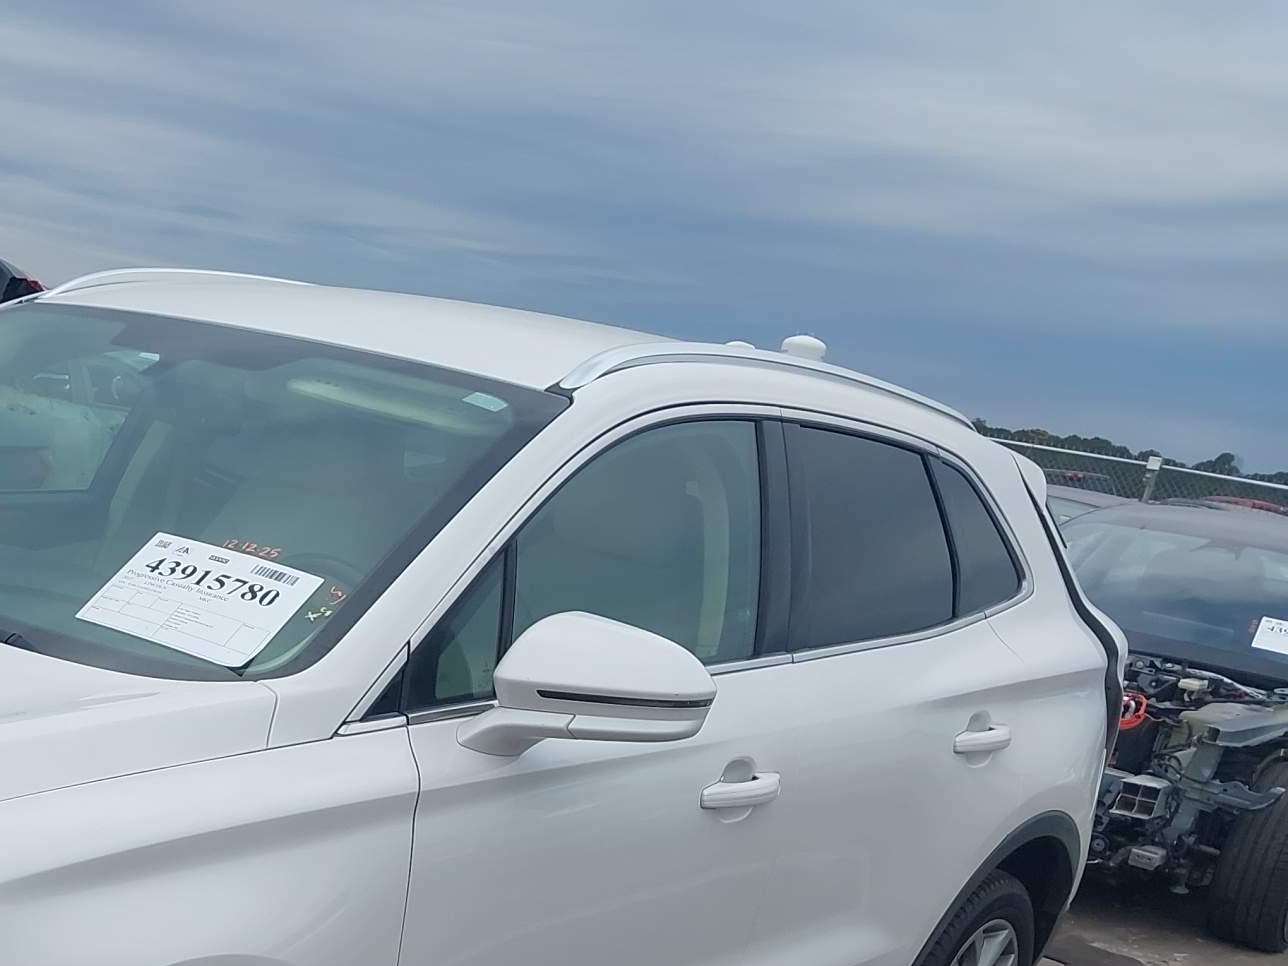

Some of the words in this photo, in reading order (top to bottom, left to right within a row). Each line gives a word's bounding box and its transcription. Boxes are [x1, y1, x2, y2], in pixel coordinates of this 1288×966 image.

[145, 557, 280, 606] 43915780
[165, 578, 194, 593] Casualty
[195, 586, 230, 603] Insurance
